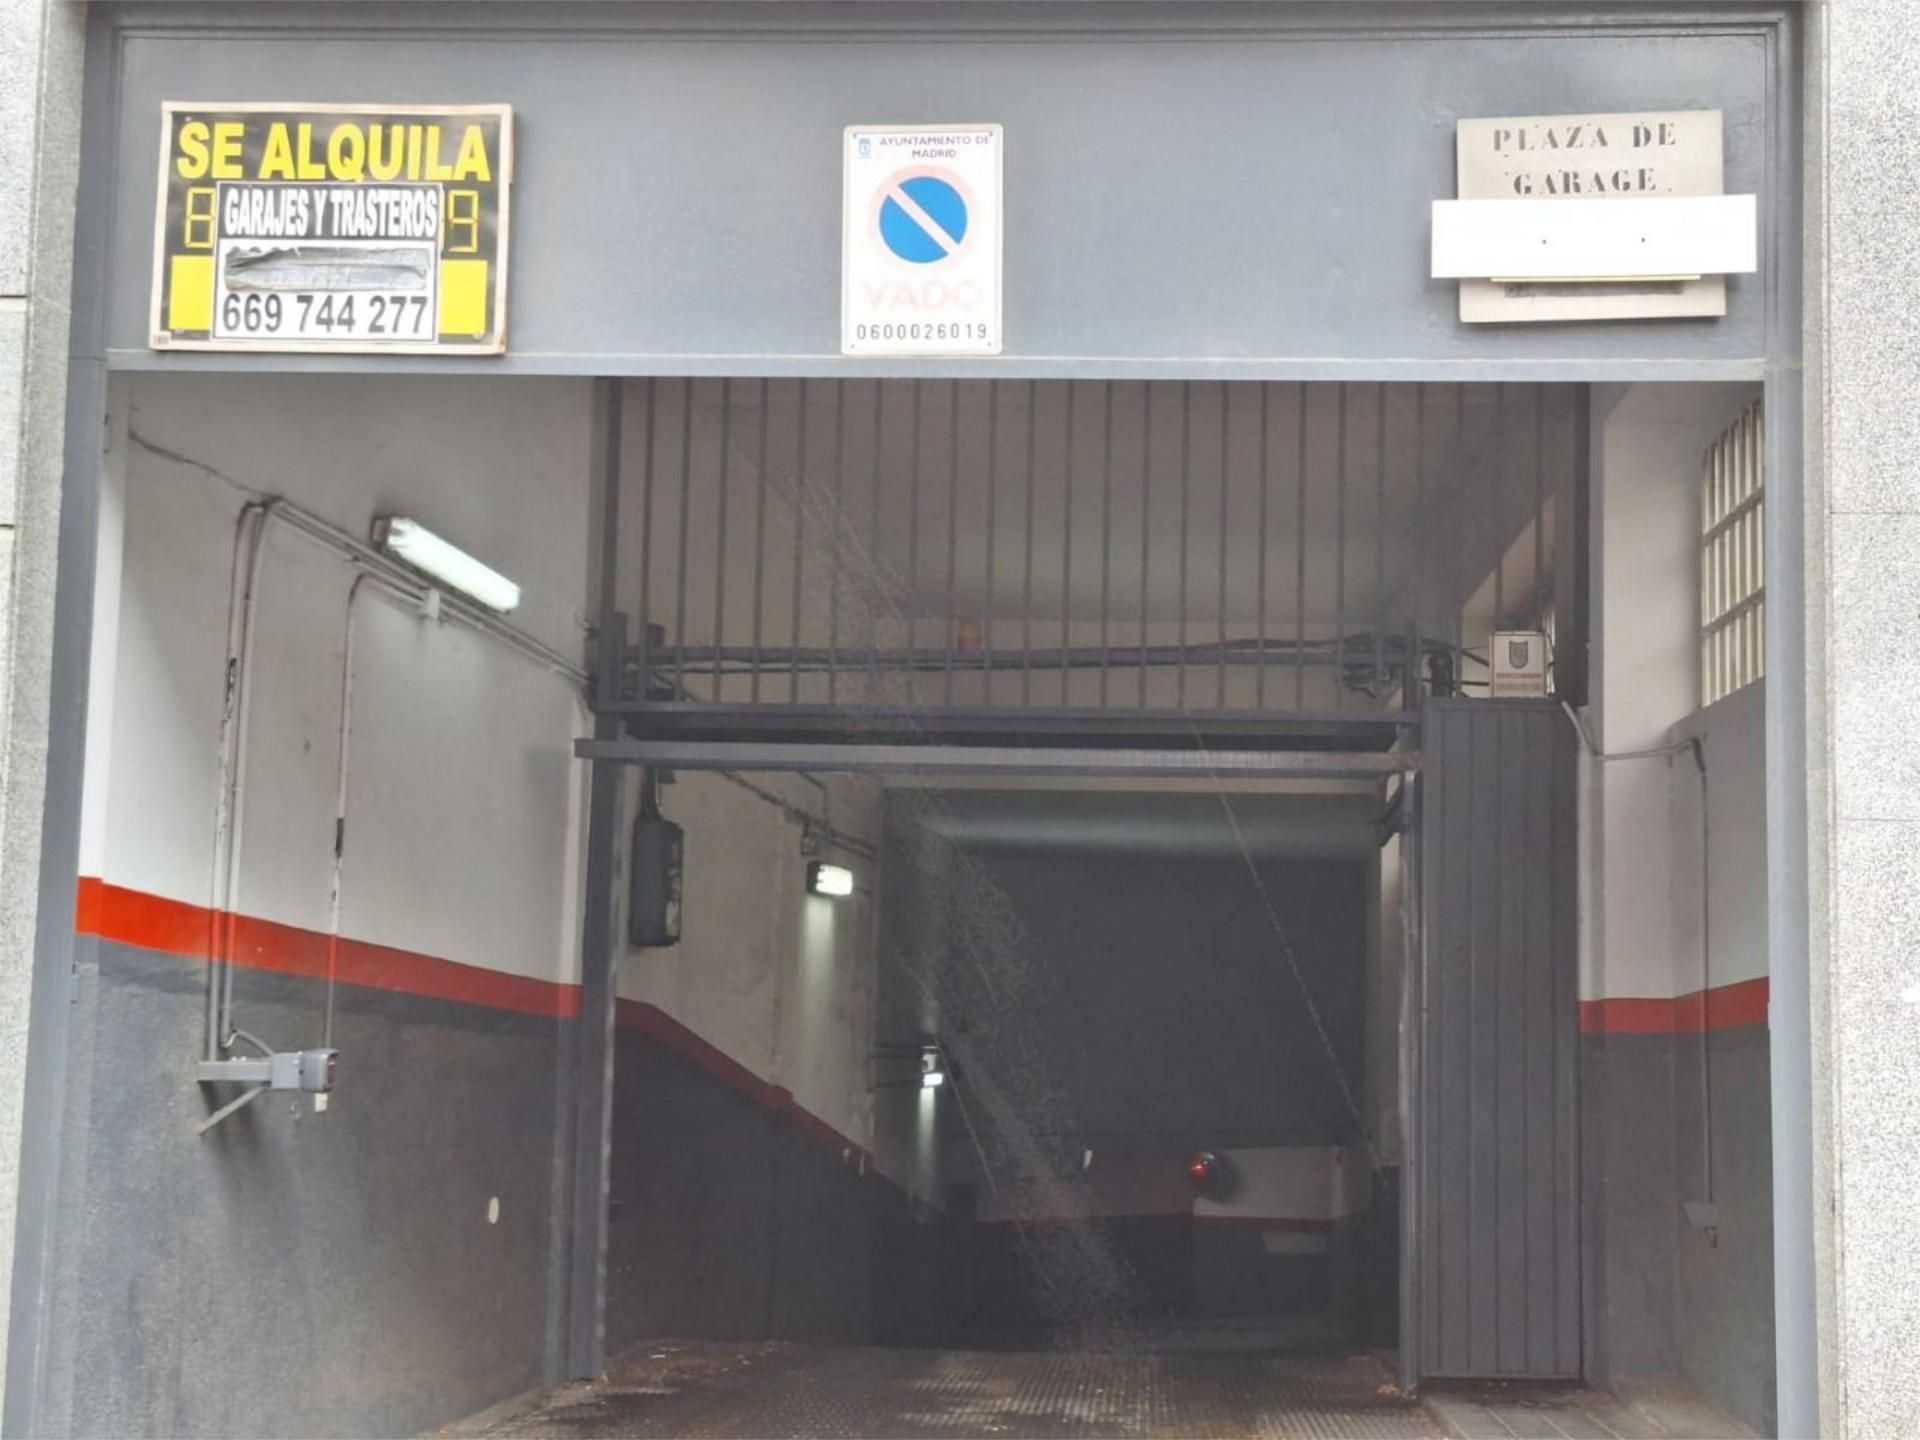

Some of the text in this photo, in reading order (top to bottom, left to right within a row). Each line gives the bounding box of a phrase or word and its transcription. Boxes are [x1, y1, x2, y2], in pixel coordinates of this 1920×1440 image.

[880, 136, 971, 146] AYUNTAMIENTO
[1493, 122, 1676, 151] PLAZA DE
[177, 121, 491, 182] SE ALQUILA
[912, 148, 957, 158] MADRID
[1513, 168, 1656, 195] GARAGE
[225, 188, 437, 237] GARAJES Y TRASTEROS
[858, 279, 985, 312] VADO
[223, 293, 428, 333] 669 744 277
[856, 323, 987, 340] 0600026019
